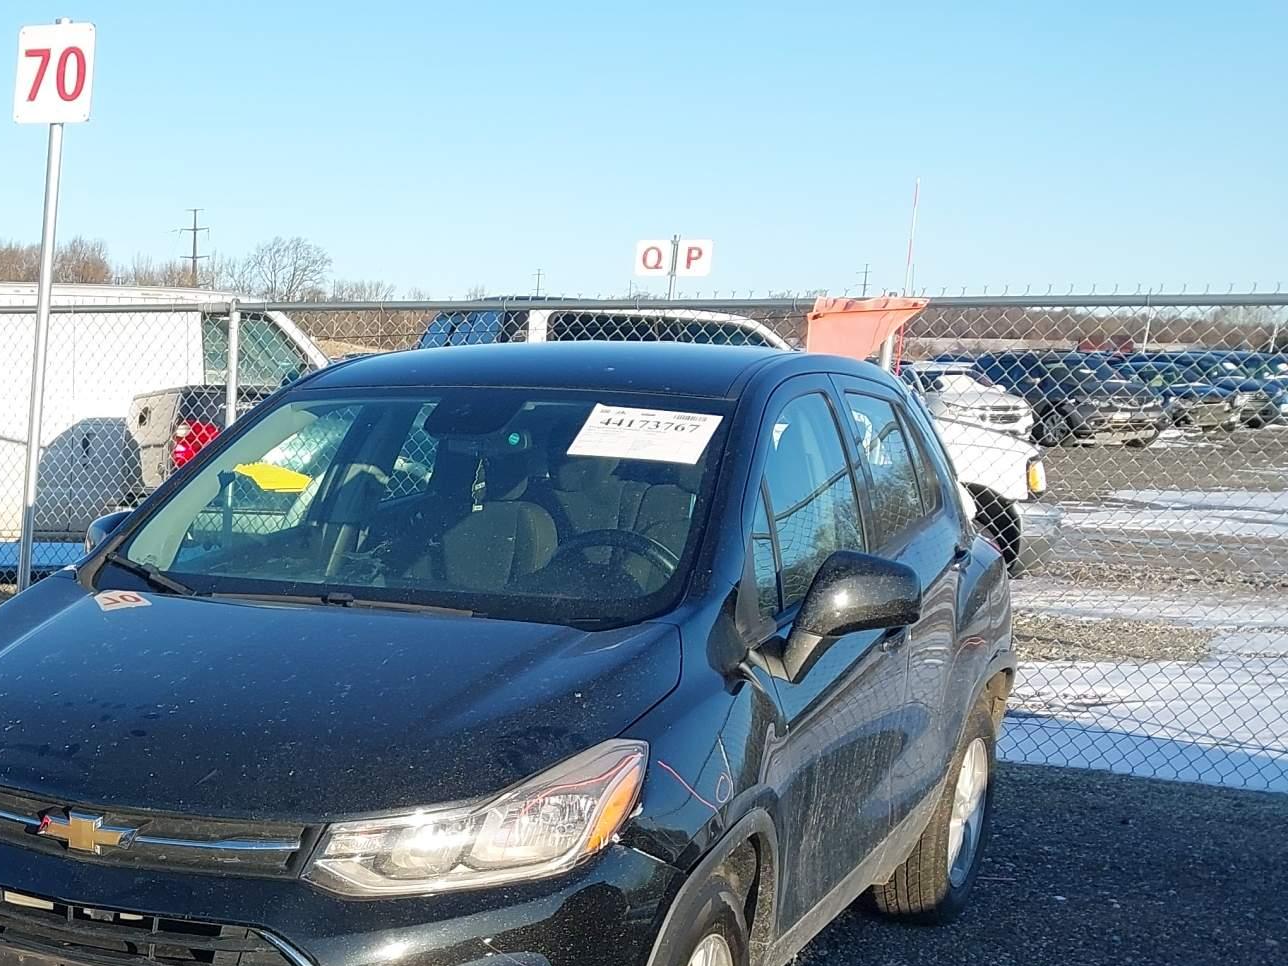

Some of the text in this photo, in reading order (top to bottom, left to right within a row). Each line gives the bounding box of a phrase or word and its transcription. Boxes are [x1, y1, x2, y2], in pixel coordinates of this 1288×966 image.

[25, 45, 86, 101] 70
[642, 245, 663, 270] Q
[685, 245, 703, 270] P
[599, 417, 701, 433] 44173767
